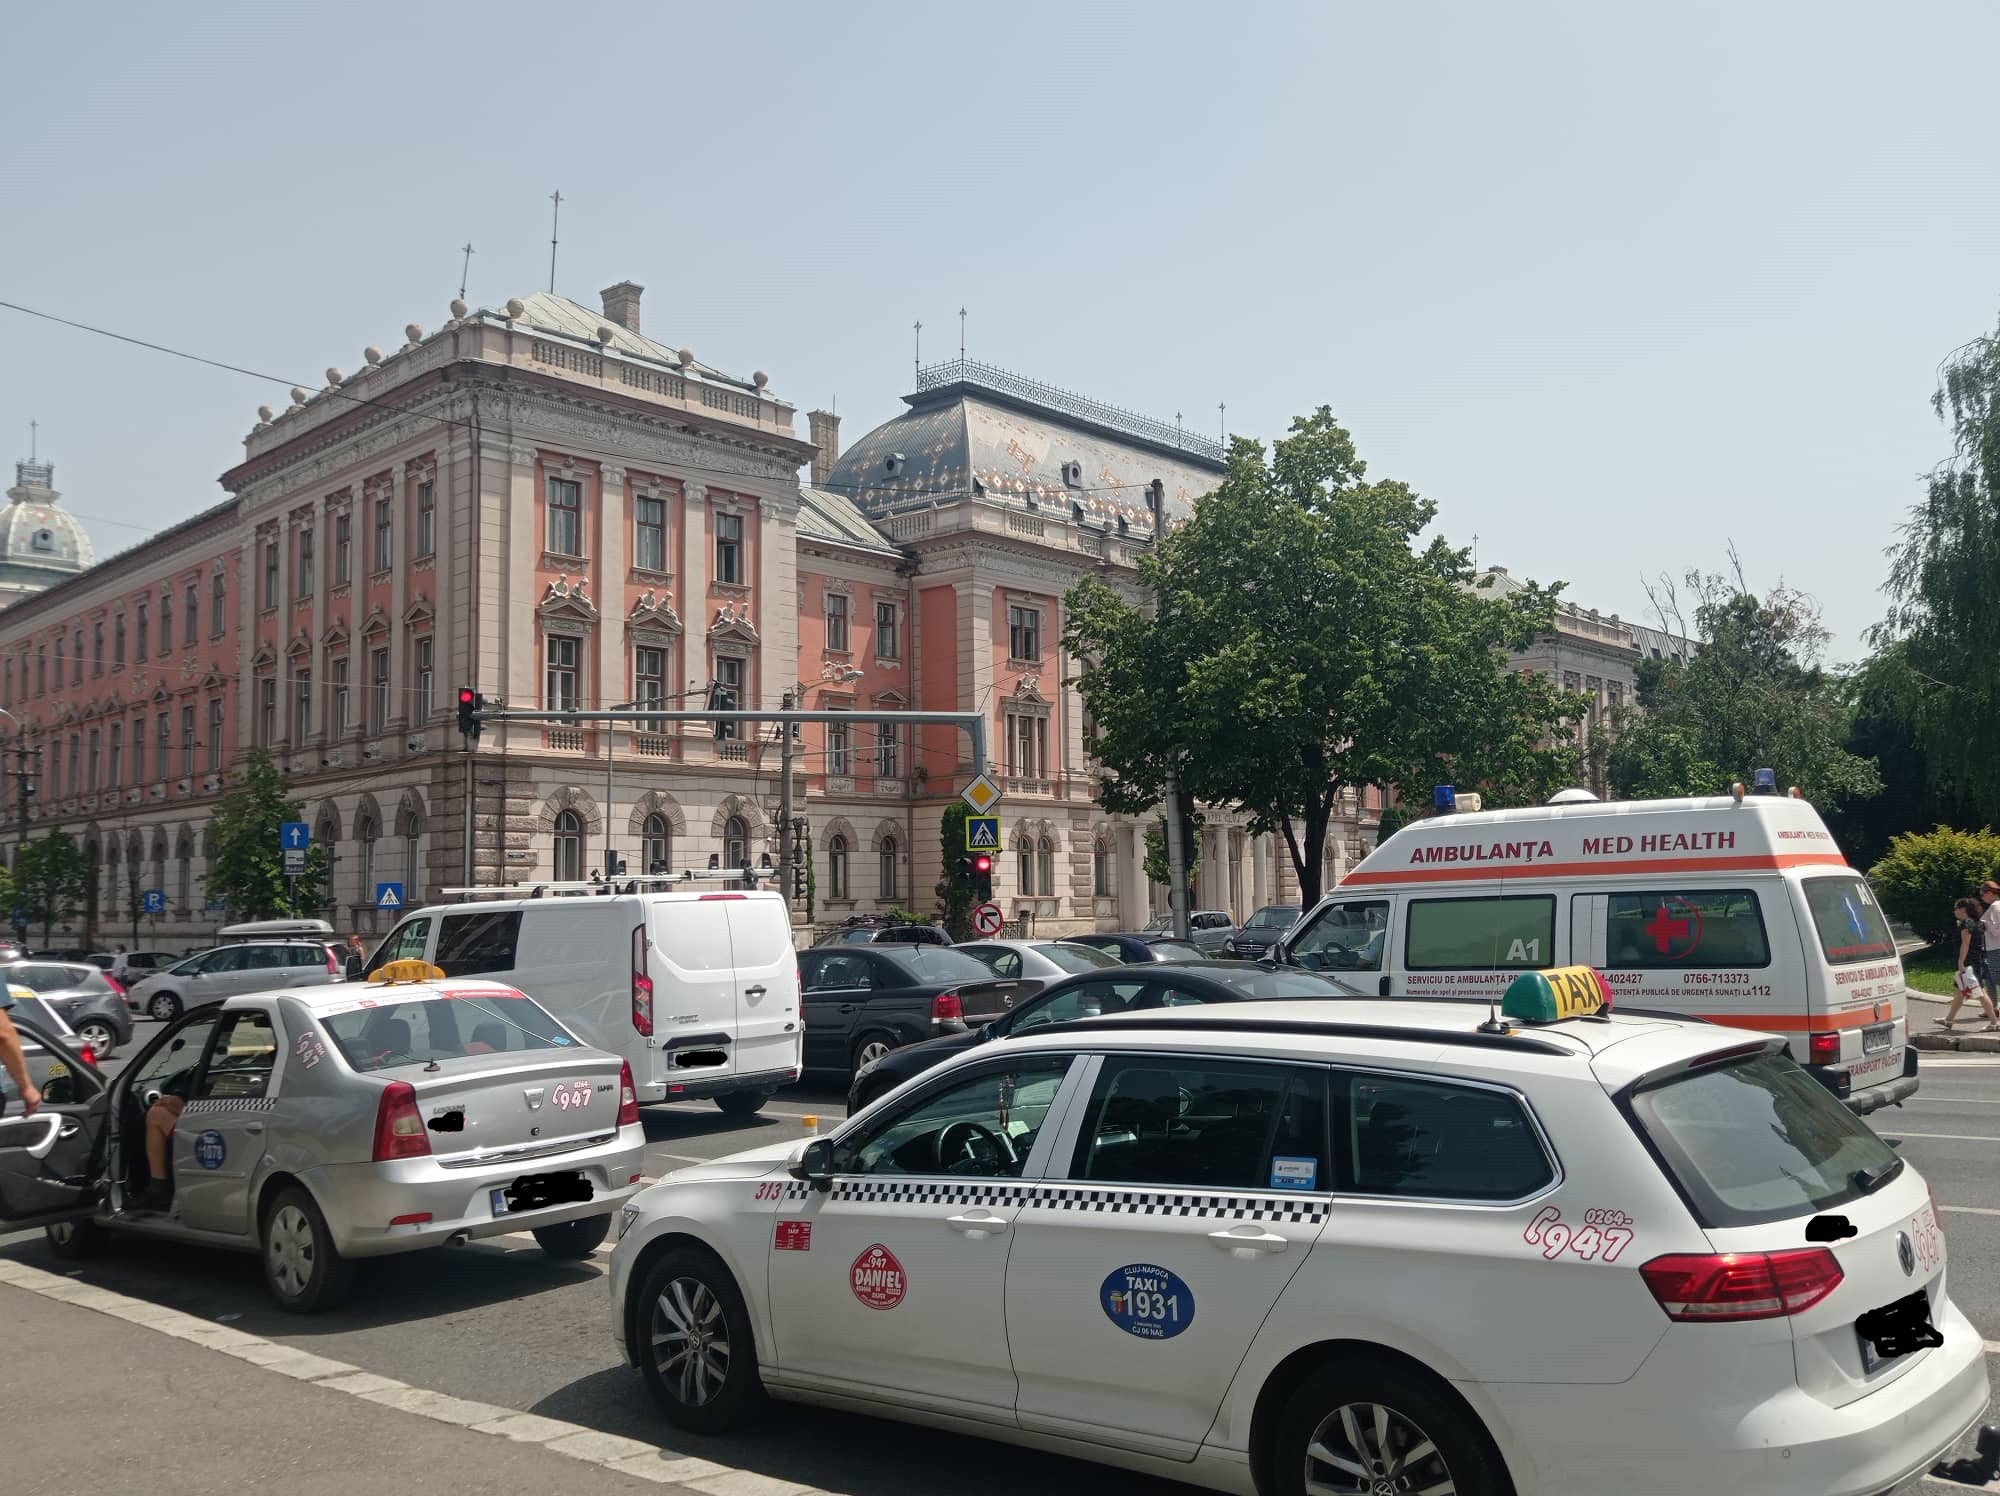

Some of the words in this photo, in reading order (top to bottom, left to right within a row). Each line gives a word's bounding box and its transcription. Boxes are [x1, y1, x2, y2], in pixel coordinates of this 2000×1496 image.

[1583, 836, 1633, 855] MED
[1640, 831, 1735, 852] HEALTH
[1506, 938, 1540, 961] A1
[1407, 975, 1442, 985] SERVICIU
[1445, 975, 1455, 984] DE
[1683, 973, 1749, 984] 0766-713373
[1547, 971, 1602, 1012] TAXI
[1671, 988, 1680, 996] DE
[1752, 985, 1771, 996] 112
[560, 1087, 593, 1112] 947
[755, 1182, 782, 1200] 313
[1543, 1223, 1634, 1262] 947
[871, 1257, 887, 1268] 947
[855, 1268, 902, 1288] DANIEL
[1124, 1266, 1169, 1280] CLUJ-NAPOCA
[1126, 1276, 1158, 1292] TAXI
[1123, 1290, 1178, 1322] 1931
